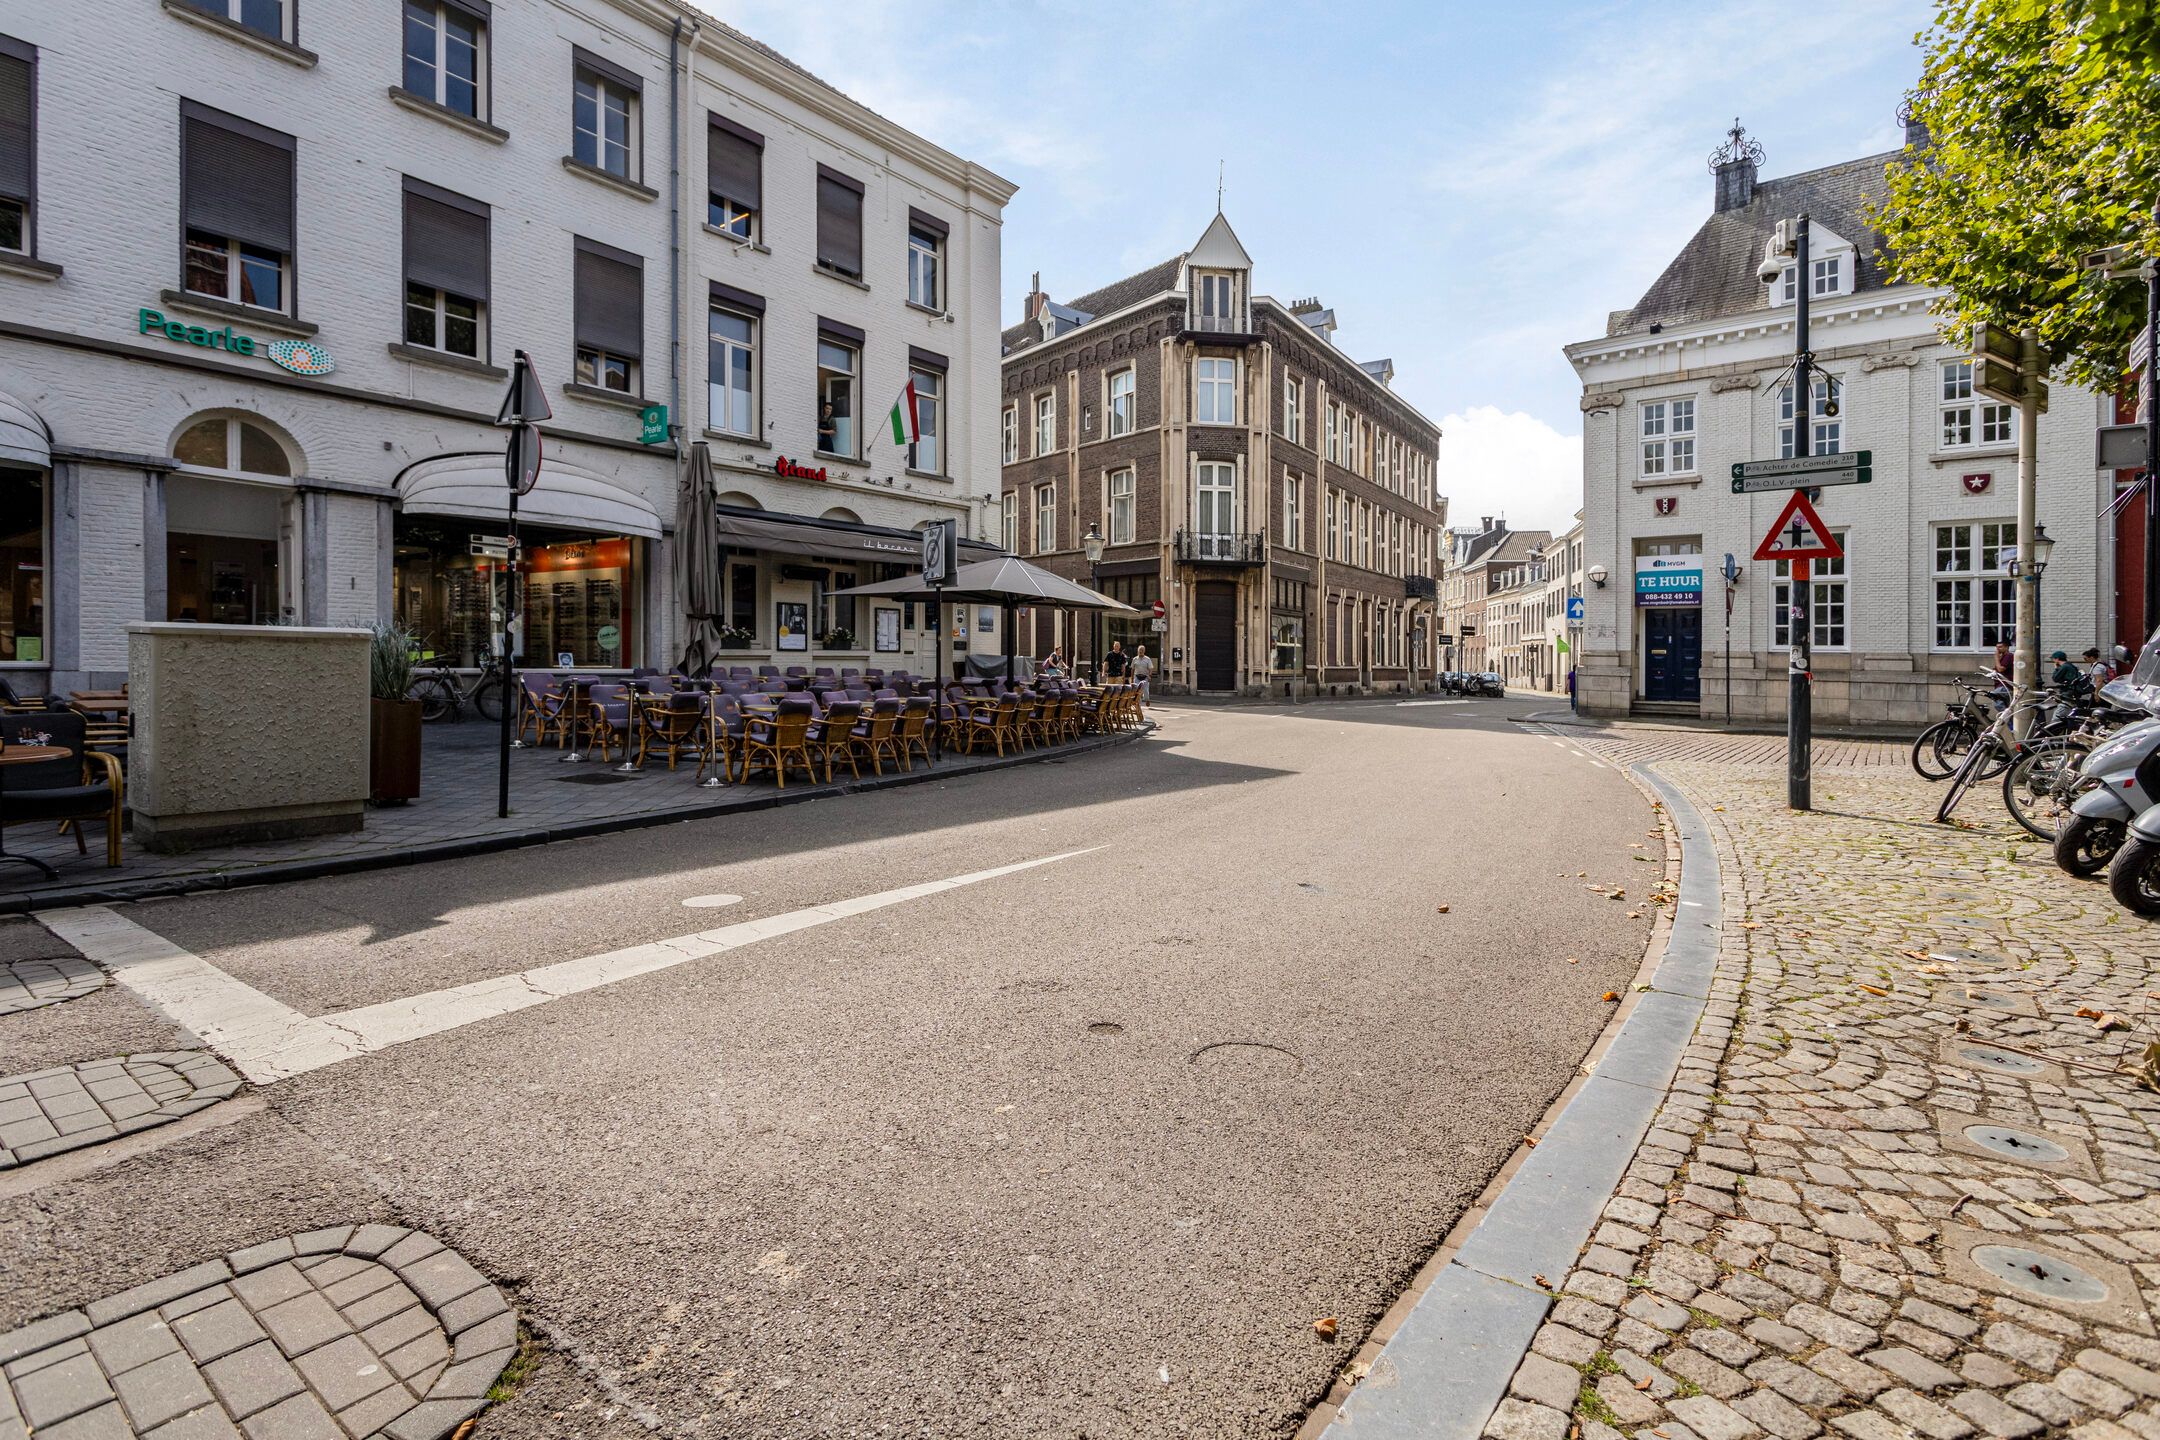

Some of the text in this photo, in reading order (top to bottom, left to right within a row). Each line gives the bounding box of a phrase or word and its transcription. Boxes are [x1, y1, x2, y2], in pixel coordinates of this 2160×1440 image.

[140, 308, 255, 356] Pearle
[644, 424, 662, 435] Pearle
[775, 455, 827, 481] Brand
[1762, 463, 1788, 472] Achter
[1802, 459, 1838, 468] Comedie
[1762, 478, 1810, 487] O.L.V.-plein
[1639, 575, 1700, 587] TE HUUR
